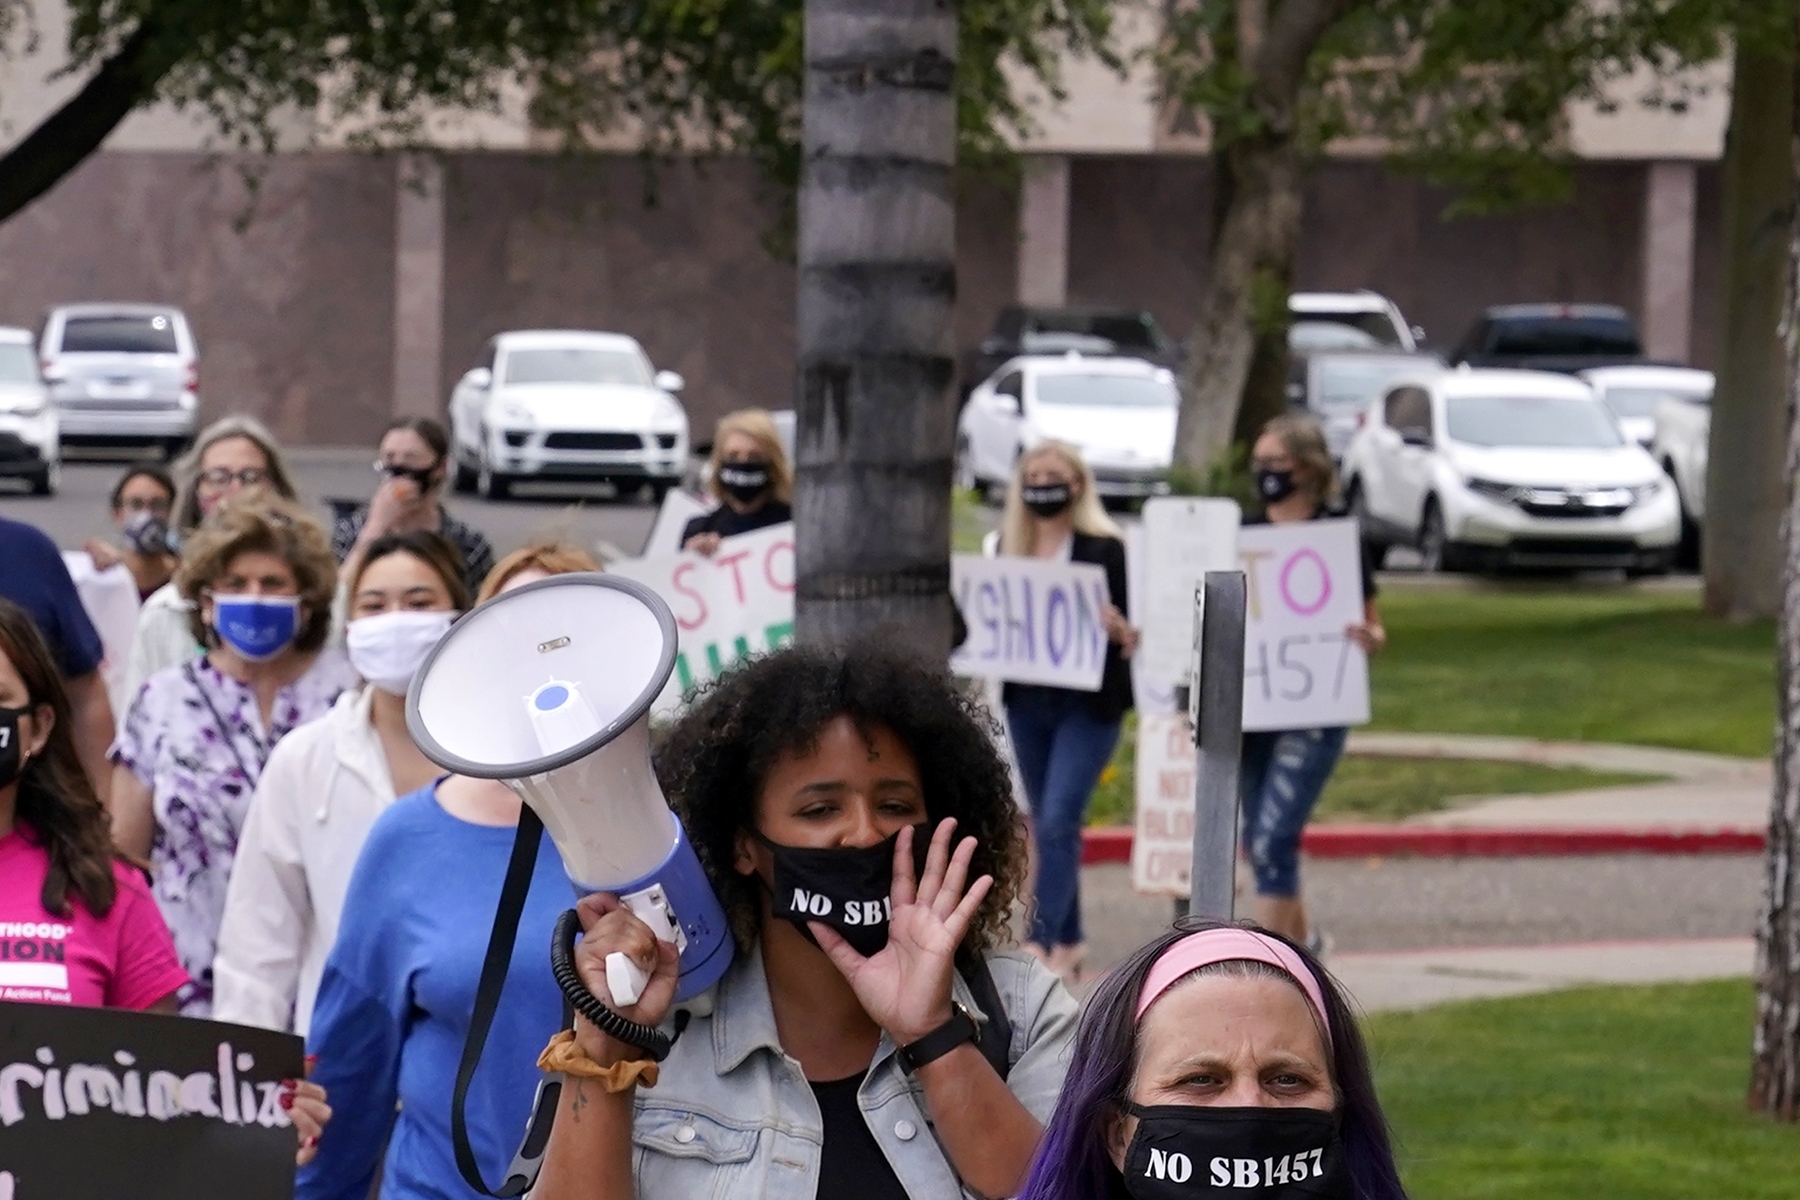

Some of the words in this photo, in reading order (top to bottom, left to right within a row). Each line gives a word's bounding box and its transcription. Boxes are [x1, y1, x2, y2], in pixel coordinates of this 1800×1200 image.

[790, 888, 832, 916] NO
[1145, 1148, 1192, 1183] NO
[1210, 1147, 1323, 1188] SB1457
